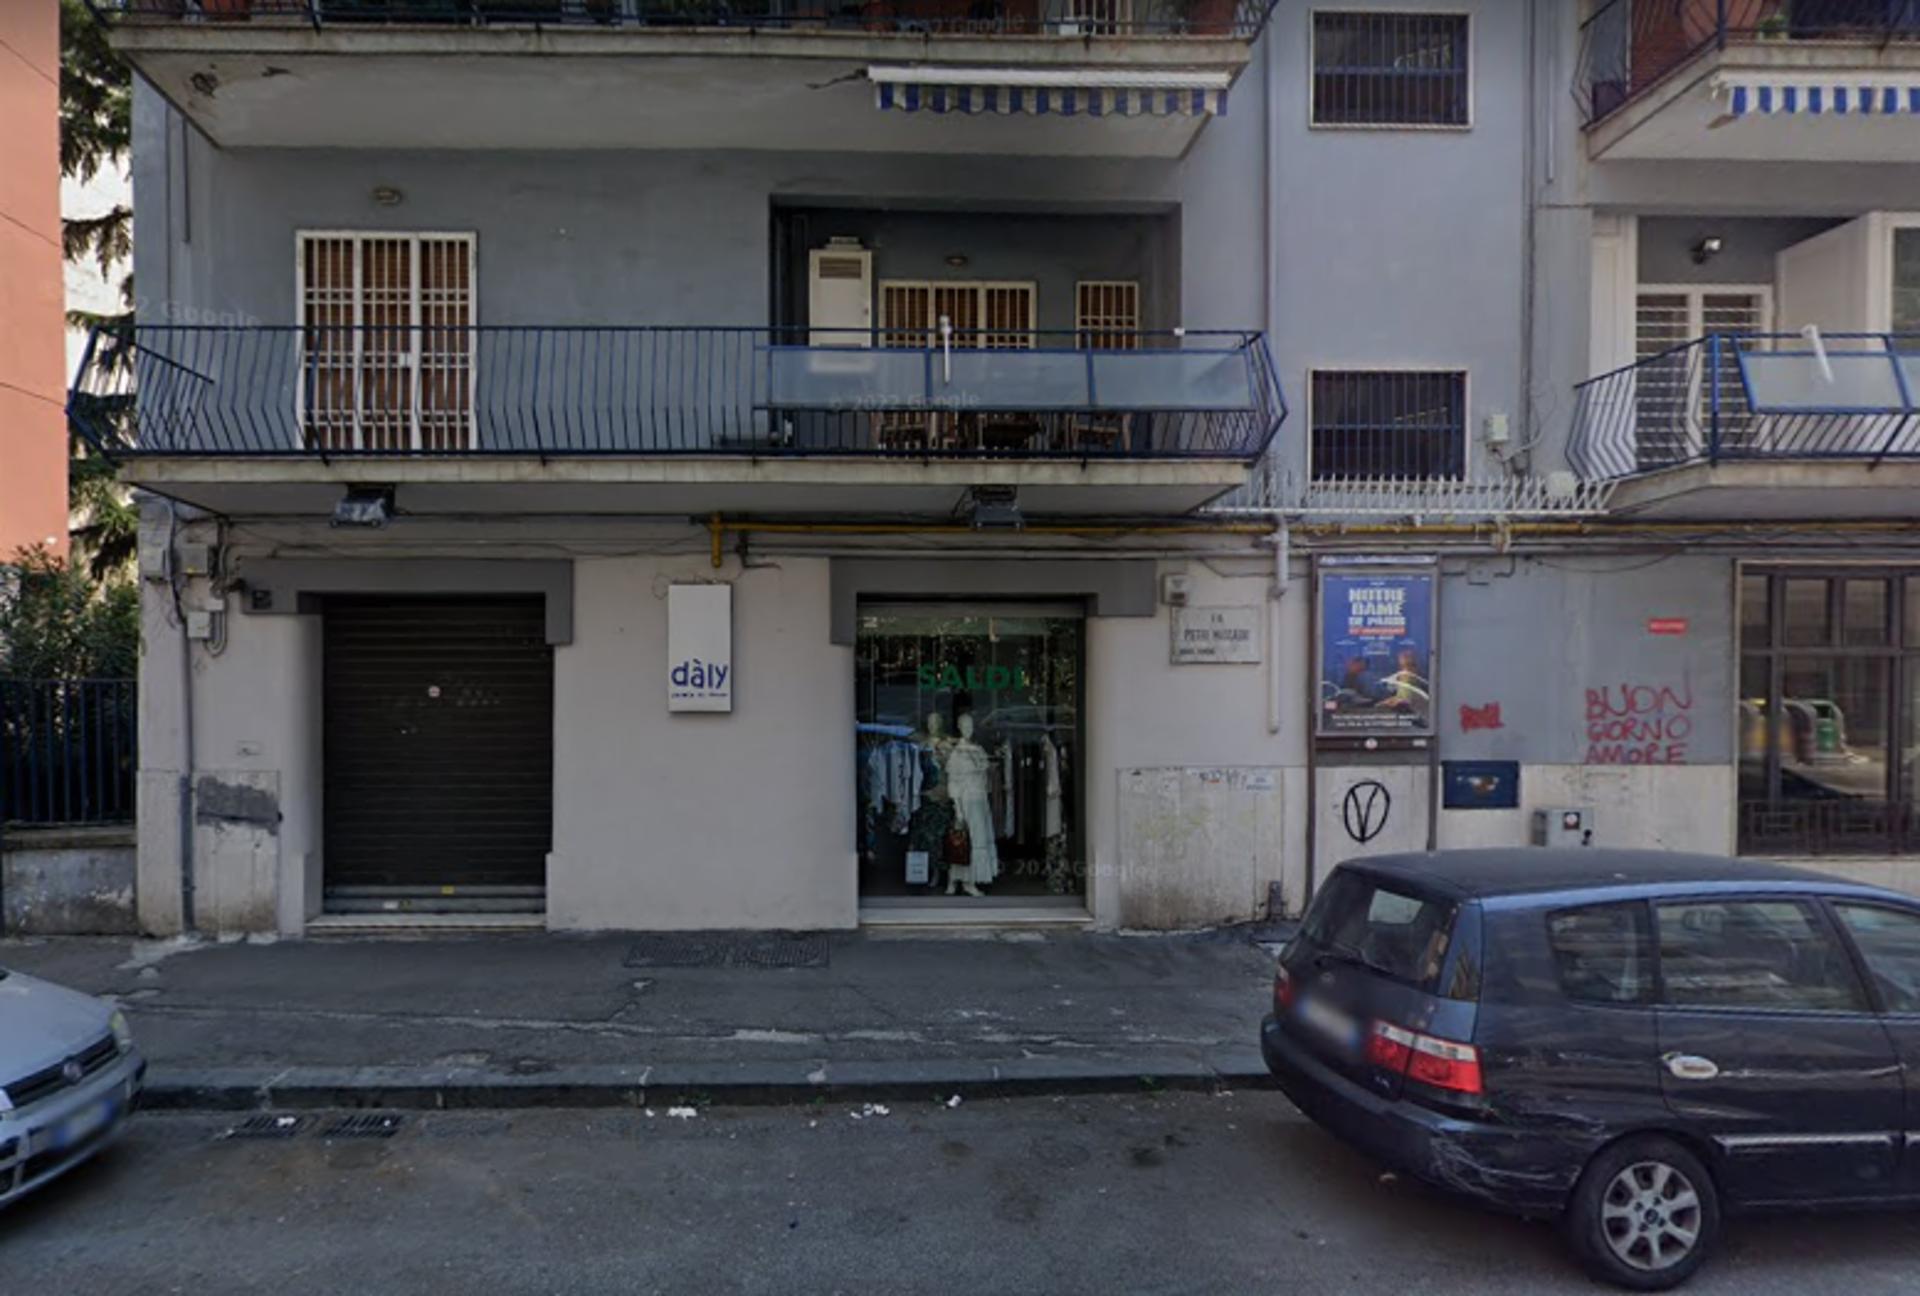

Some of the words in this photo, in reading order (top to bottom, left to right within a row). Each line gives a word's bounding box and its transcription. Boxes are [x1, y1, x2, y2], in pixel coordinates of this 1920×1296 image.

[671, 658, 729, 690] dàly
[917, 663, 1025, 692] SALDI
[1585, 676, 1693, 720] BUON
[1584, 742, 1688, 765] AMORE
